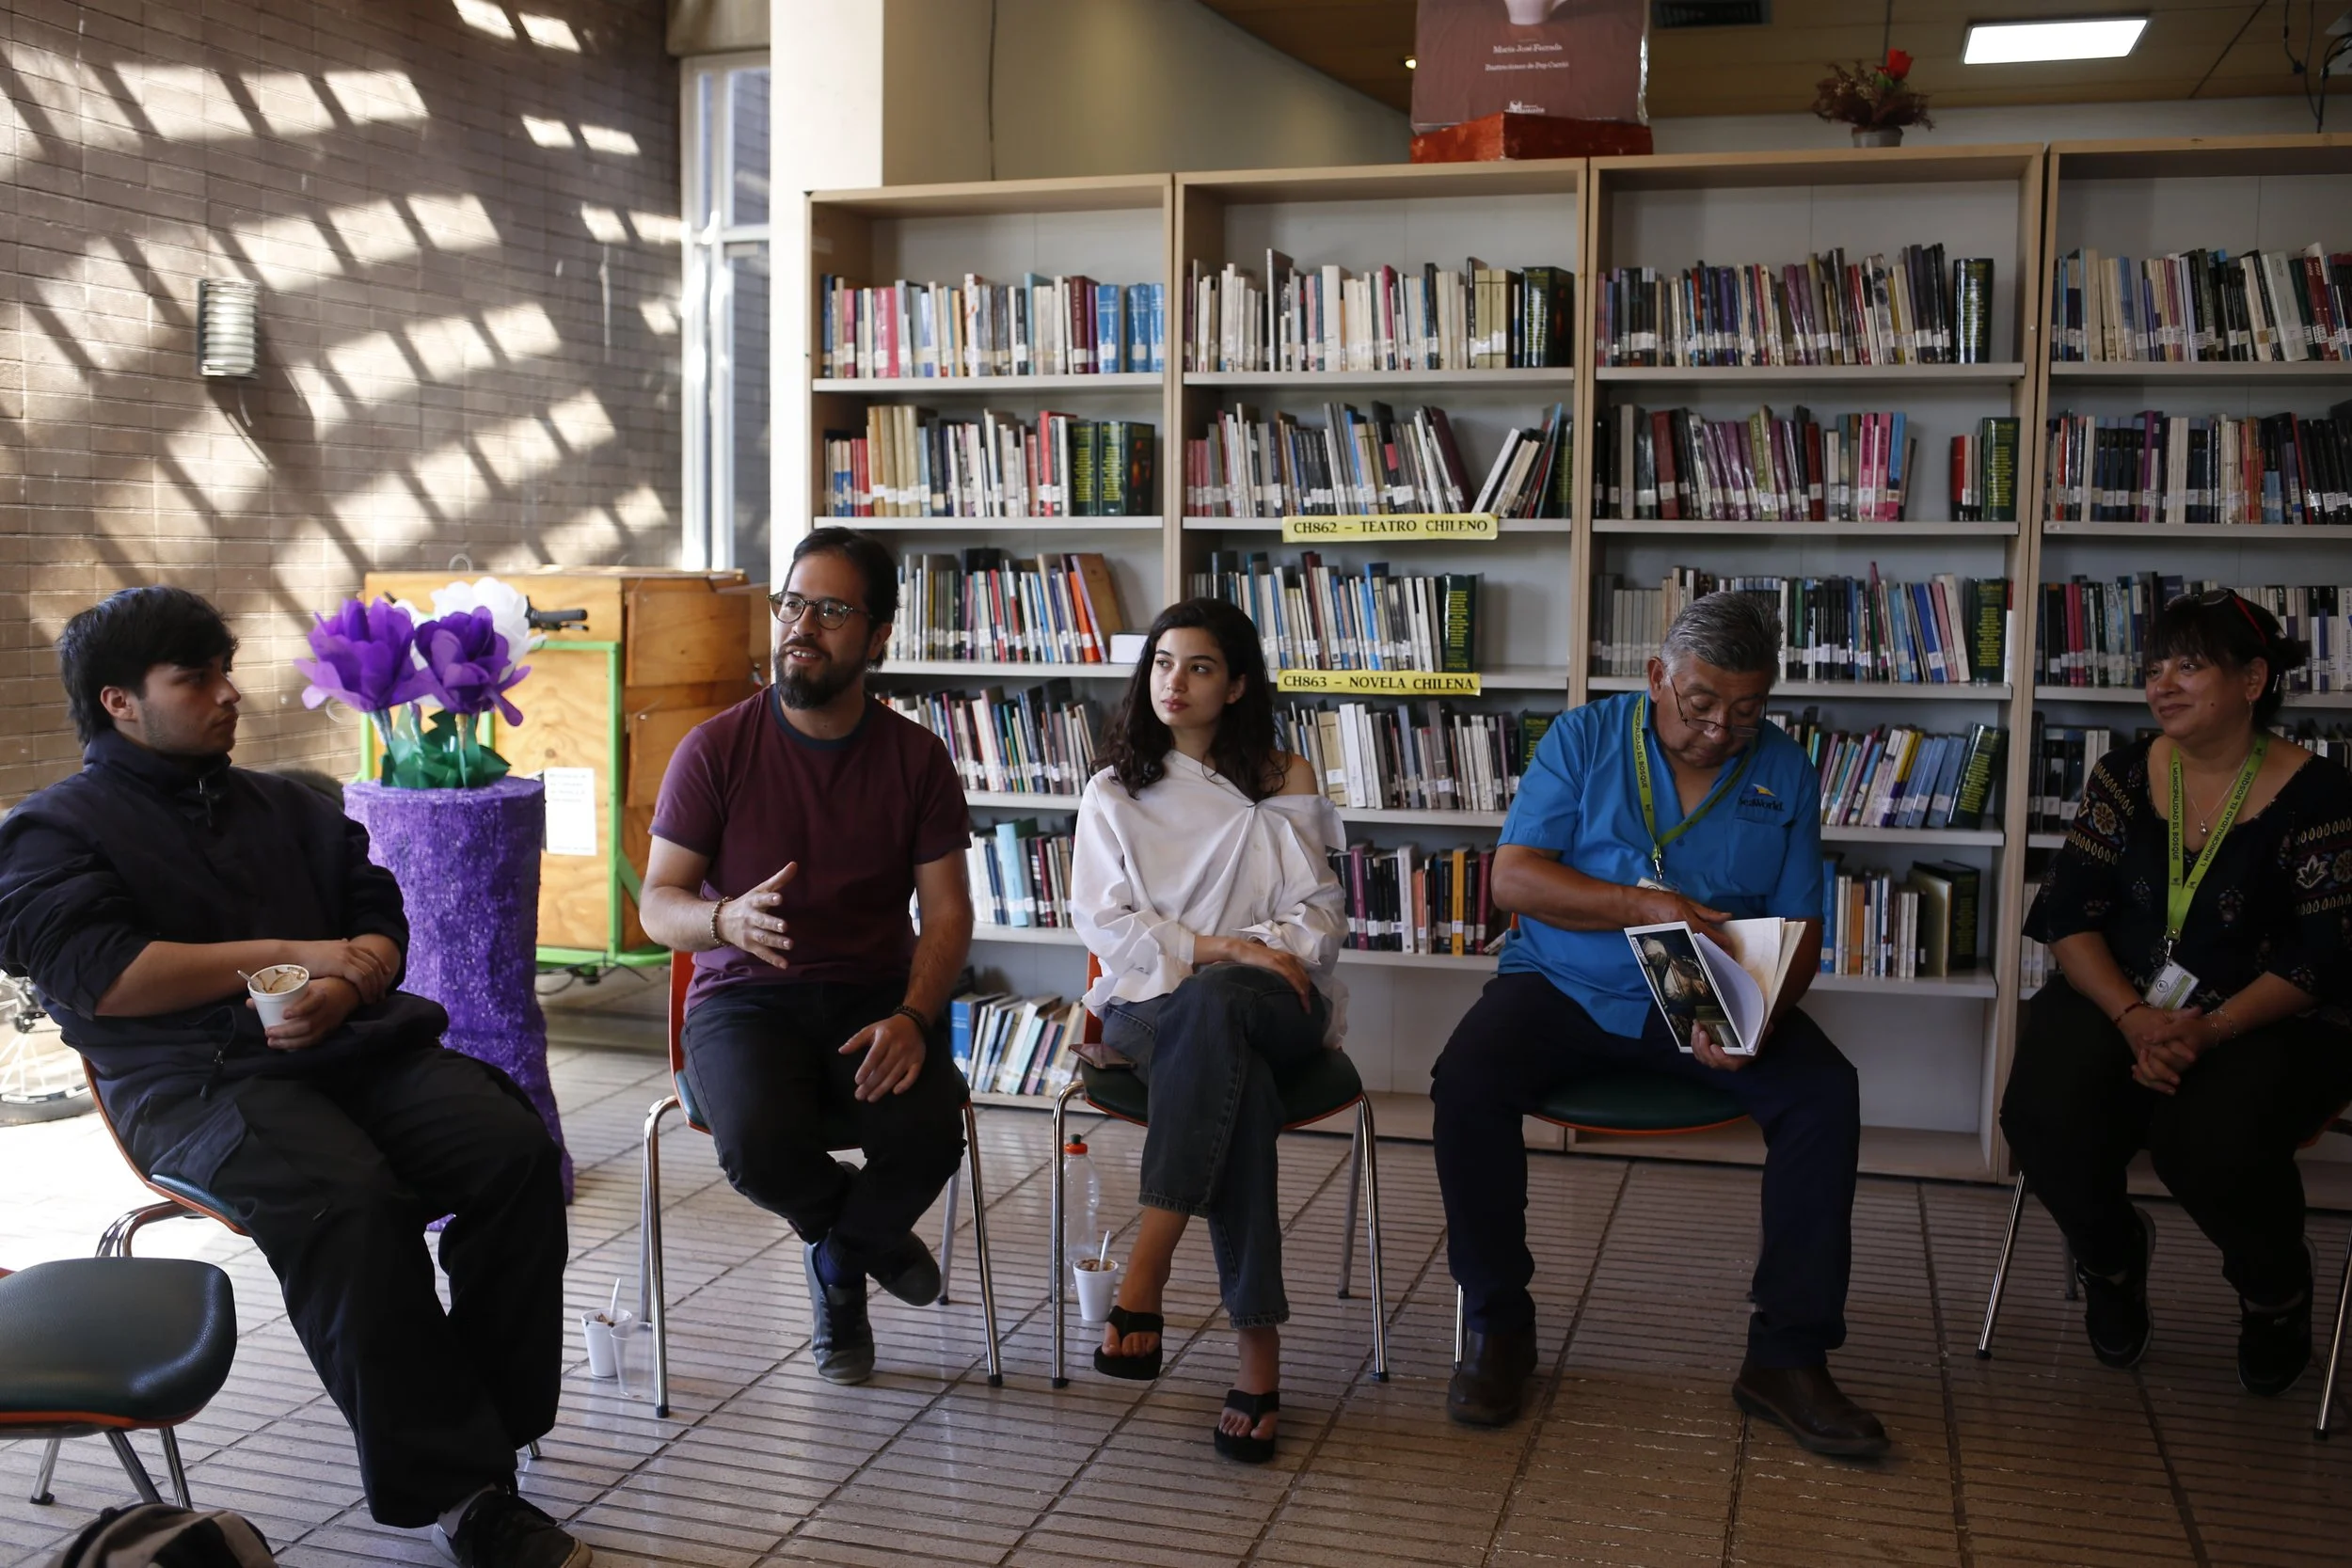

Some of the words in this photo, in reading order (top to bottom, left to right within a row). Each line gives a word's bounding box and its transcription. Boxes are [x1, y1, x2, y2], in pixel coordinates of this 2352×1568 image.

[1294, 521, 1338, 534] CH862
[1360, 519, 1418, 533] TEATRO
[1425, 519, 1488, 532] CHILENO
[1283, 675, 1327, 688] CH863
[1349, 675, 1406, 689] NOVELA
[1413, 677, 1475, 690] CHILENA
[1638, 752, 1644, 761] EL
[1639, 761, 1648, 789] BOSQUE
[2203, 811, 2233, 861] MUNICIPALIDAD
[2230, 800, 2239, 810] EL
[2235, 770, 2253, 800] BOSQUE
[2172, 821, 2179, 831] EL
